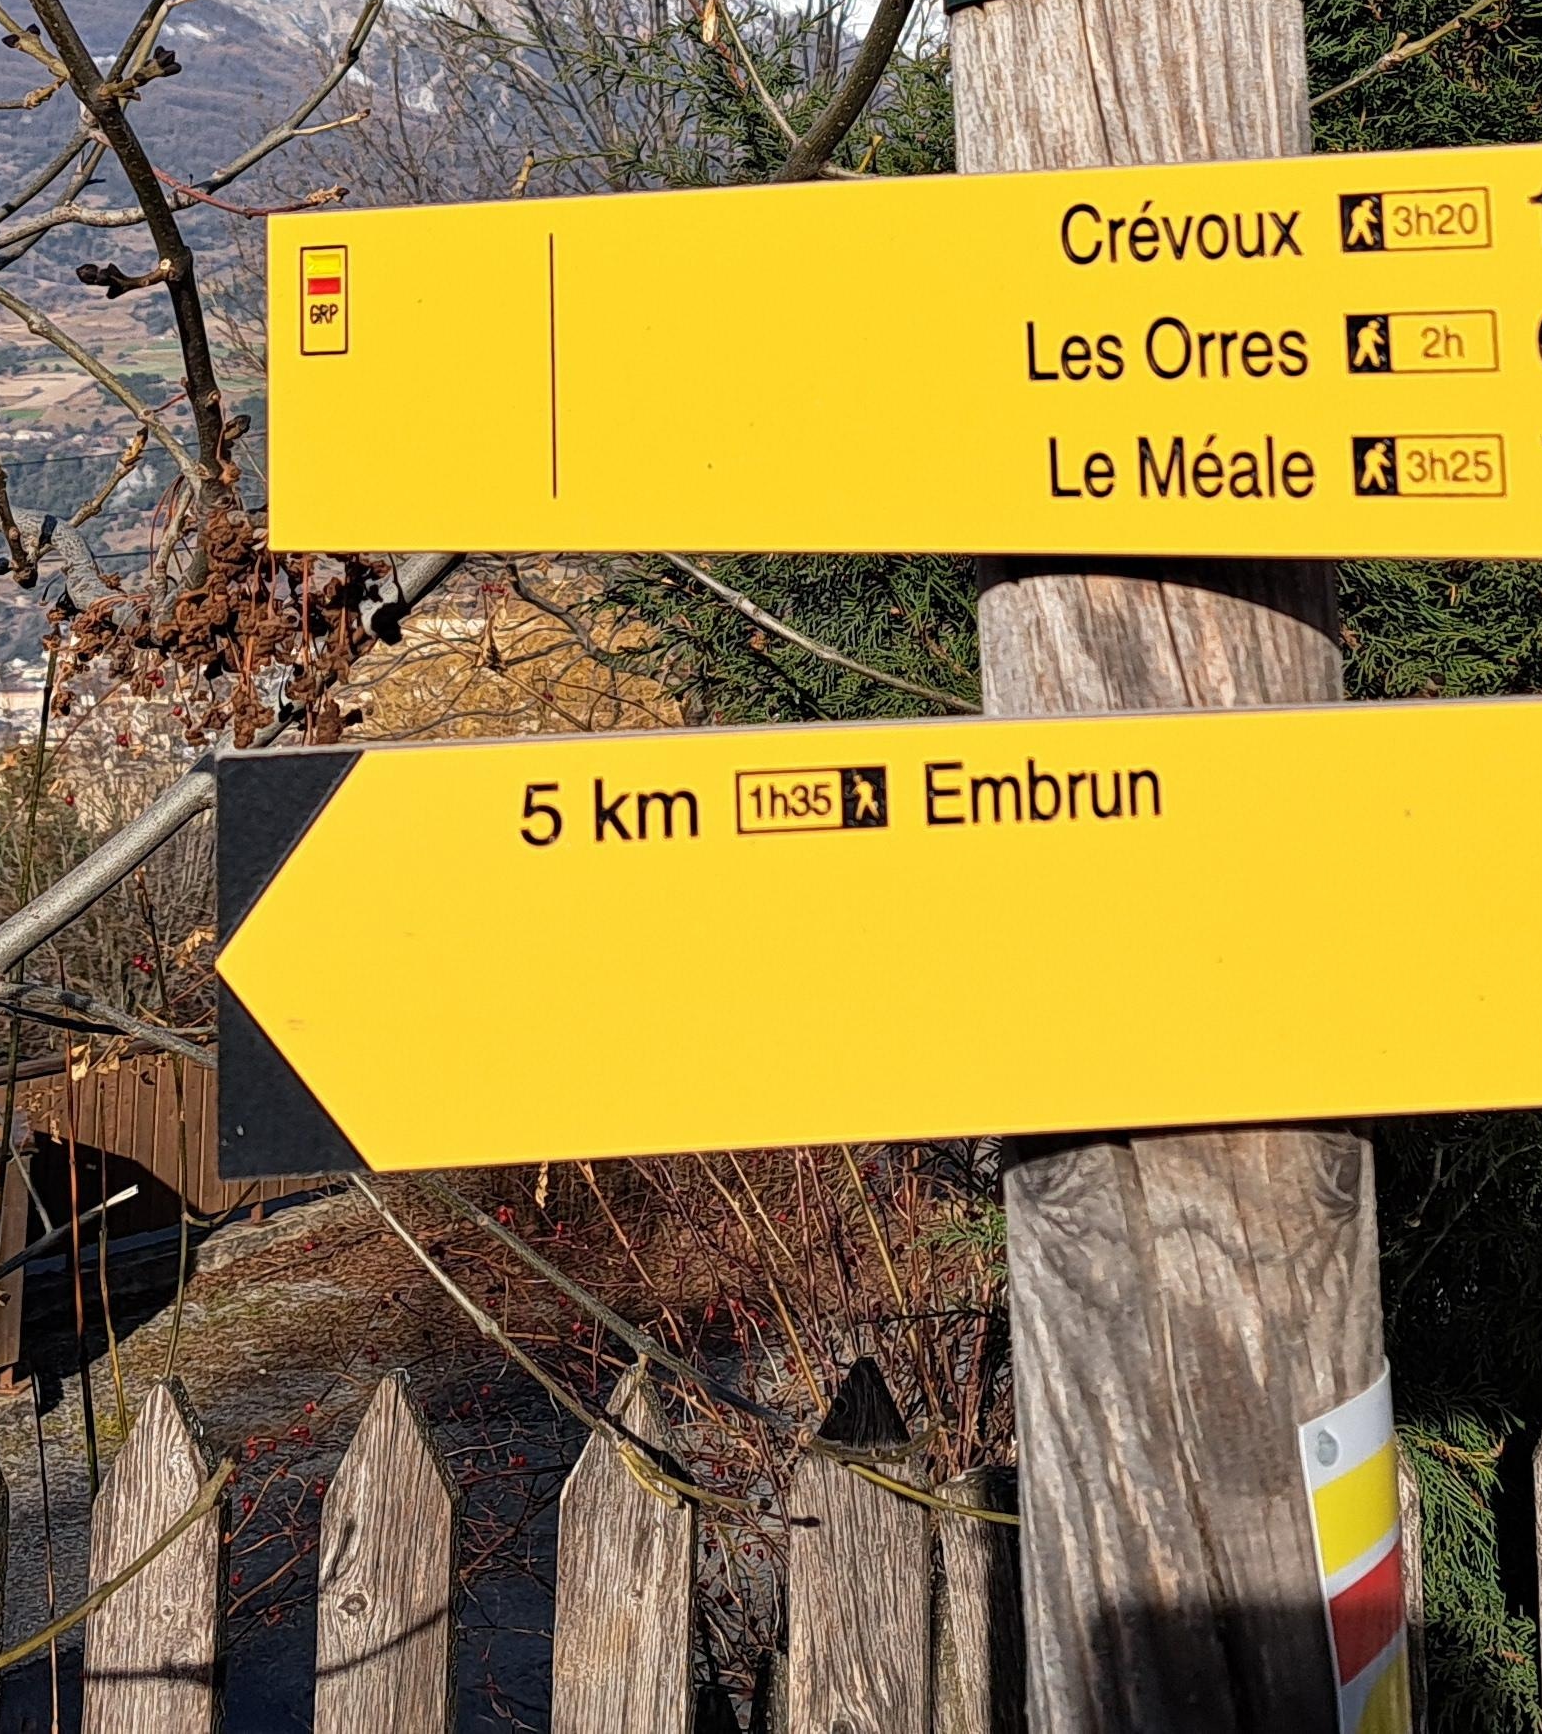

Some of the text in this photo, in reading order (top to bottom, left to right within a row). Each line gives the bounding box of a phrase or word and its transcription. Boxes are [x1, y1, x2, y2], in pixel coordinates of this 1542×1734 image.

[1061, 200, 1302, 265] Crévoux
[1392, 203, 1478, 237] 3h20
[310, 303, 339, 325] GRP
[1026, 321, 1125, 381] Les
[1146, 316, 1309, 380] Orres
[1421, 326, 1465, 360] 2h
[1049, 437, 1116, 498] Le
[1138, 433, 1315, 498] Méale
[1405, 450, 1493, 483] 3h25
[519, 757, 1162, 846] 5 km 1h35 Embrun
